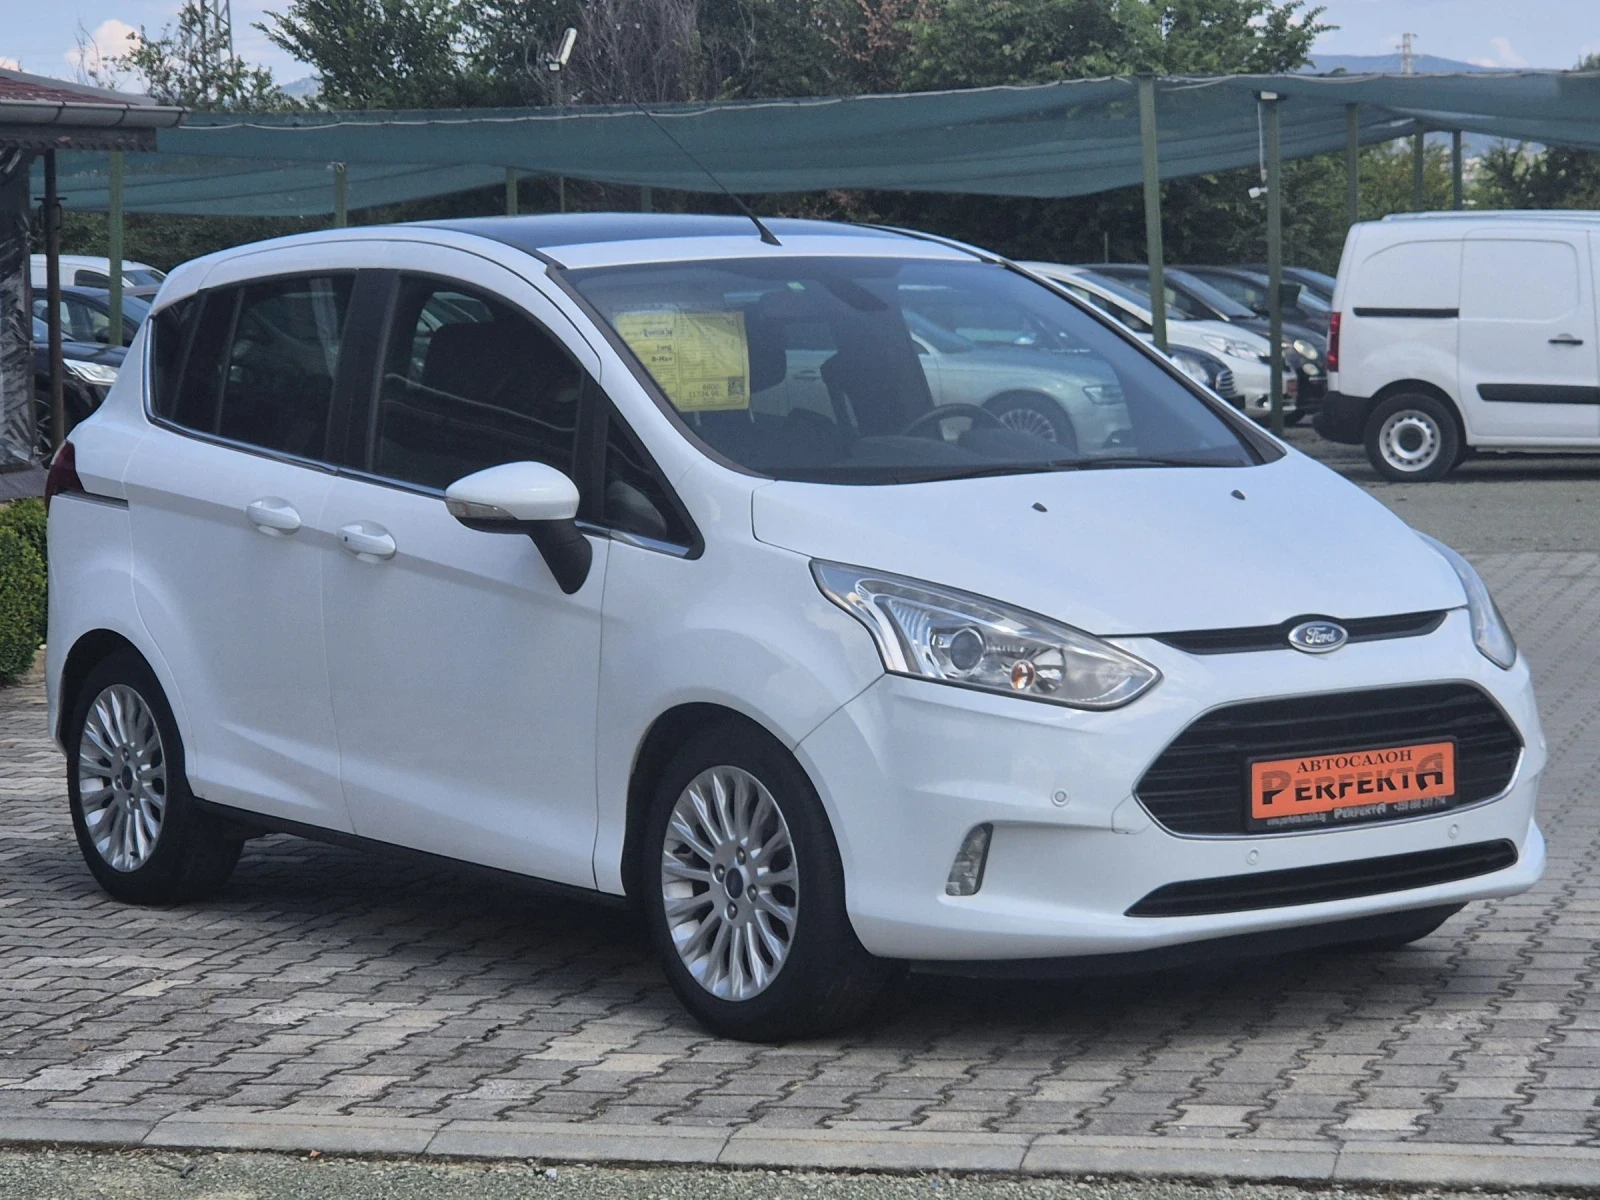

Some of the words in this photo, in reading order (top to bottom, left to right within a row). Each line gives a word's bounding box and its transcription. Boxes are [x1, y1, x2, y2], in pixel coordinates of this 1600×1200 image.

[1305, 627, 1336, 644] Ford
[1296, 749, 1413, 774] АВТОСАЛОН
[1261, 752, 1445, 805] PERFEKTA
